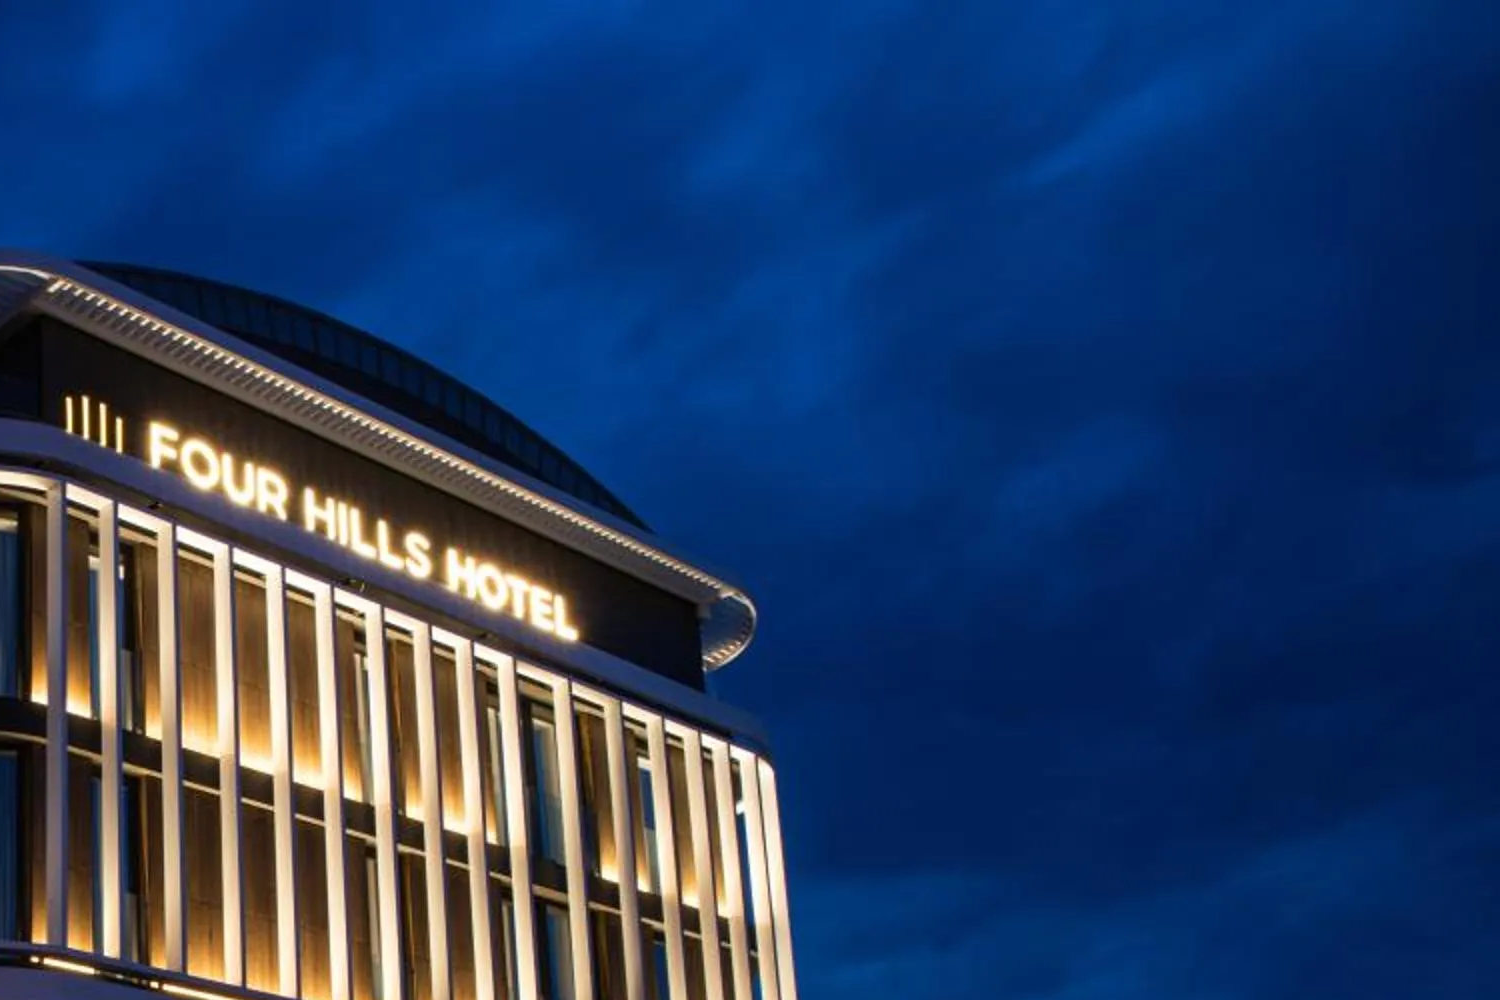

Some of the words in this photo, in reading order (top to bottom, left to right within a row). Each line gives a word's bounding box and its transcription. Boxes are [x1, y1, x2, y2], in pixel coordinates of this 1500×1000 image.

[147, 420, 290, 522] FOUR
[301, 487, 434, 581] HILLS
[442, 547, 580, 643] HOTEL
